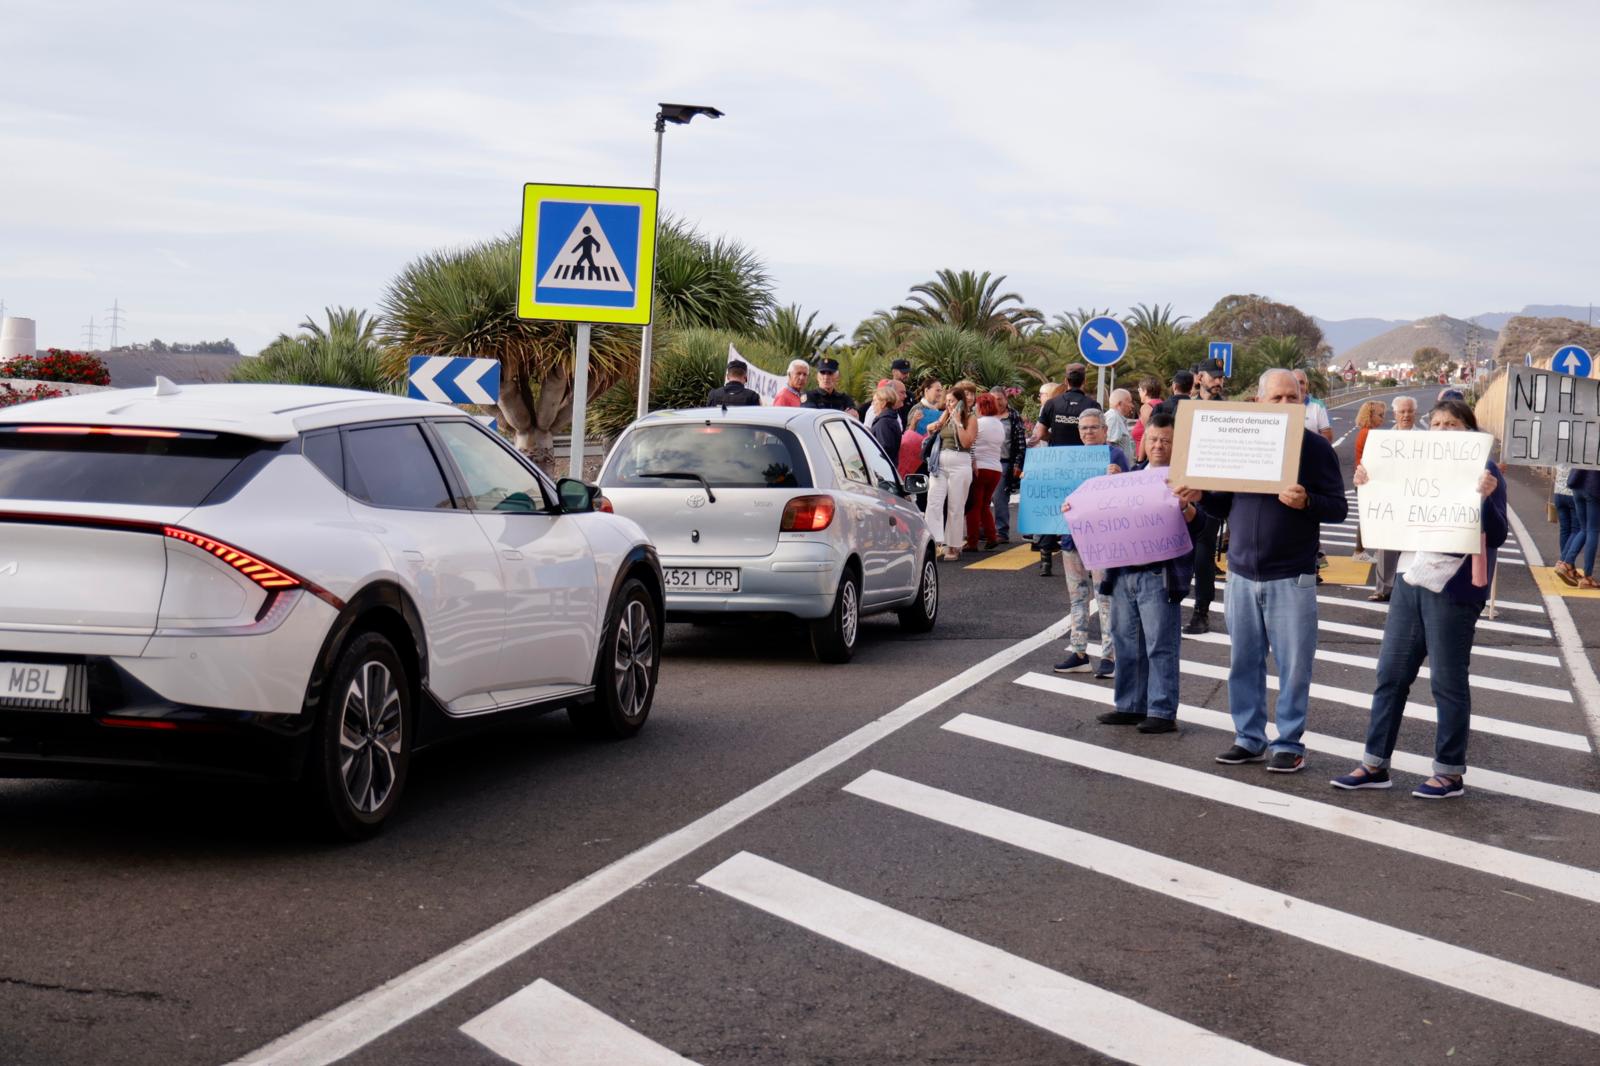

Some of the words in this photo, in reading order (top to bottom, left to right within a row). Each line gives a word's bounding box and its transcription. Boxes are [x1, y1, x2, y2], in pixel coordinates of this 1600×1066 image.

[1514, 373, 1548, 413] NO
[1558, 376, 1584, 415] AL
[1200, 414, 1209, 423] El
[1209, 415, 1244, 424] Secadero
[1245, 416, 1280, 425] denuncia
[1403, 478, 1440, 498] NOS
[1031, 502, 1062, 517] SOLU
[1367, 501, 1394, 521] HA
[1072, 520, 1094, 536] HA
[1099, 517, 1130, 533] SIDO
[1135, 512, 1165, 529] UNA
[1081, 542, 1129, 560] HAPUZA
[1131, 540, 1139, 556] Y
[664, 571, 697, 586] 4521
[706, 571, 733, 586] CPR
[8, 667, 56, 694] MBL
